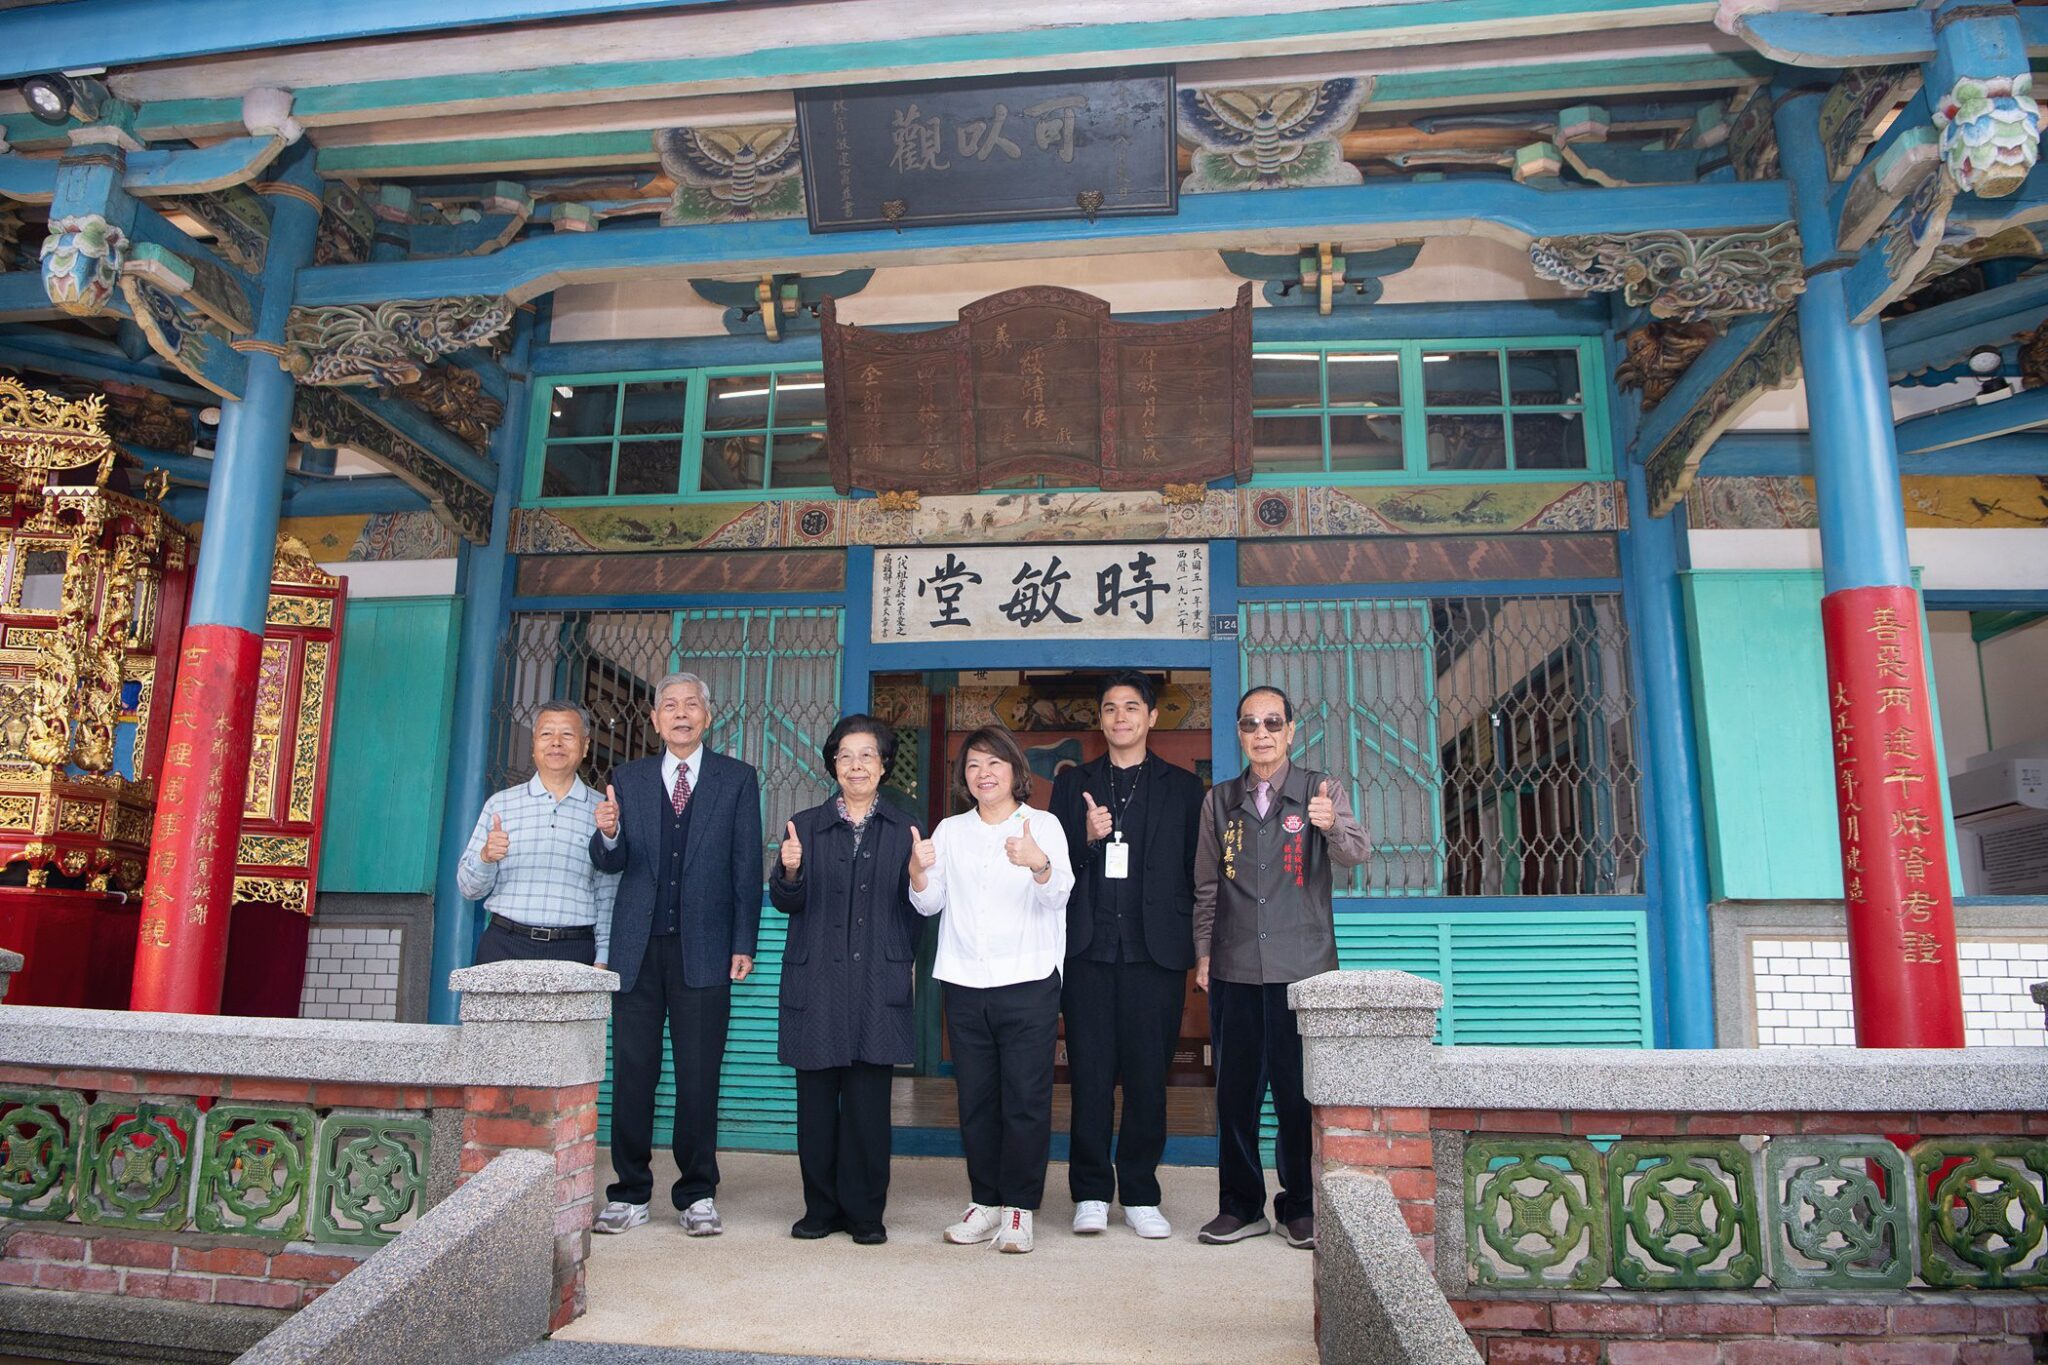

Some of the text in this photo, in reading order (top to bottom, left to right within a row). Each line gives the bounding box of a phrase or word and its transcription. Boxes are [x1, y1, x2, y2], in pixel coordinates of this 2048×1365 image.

[918, 552, 1171, 628] 時敏堂
[1219, 620, 1236, 630] 124
[1833, 681, 1868, 904] 大正十一年八月建造
